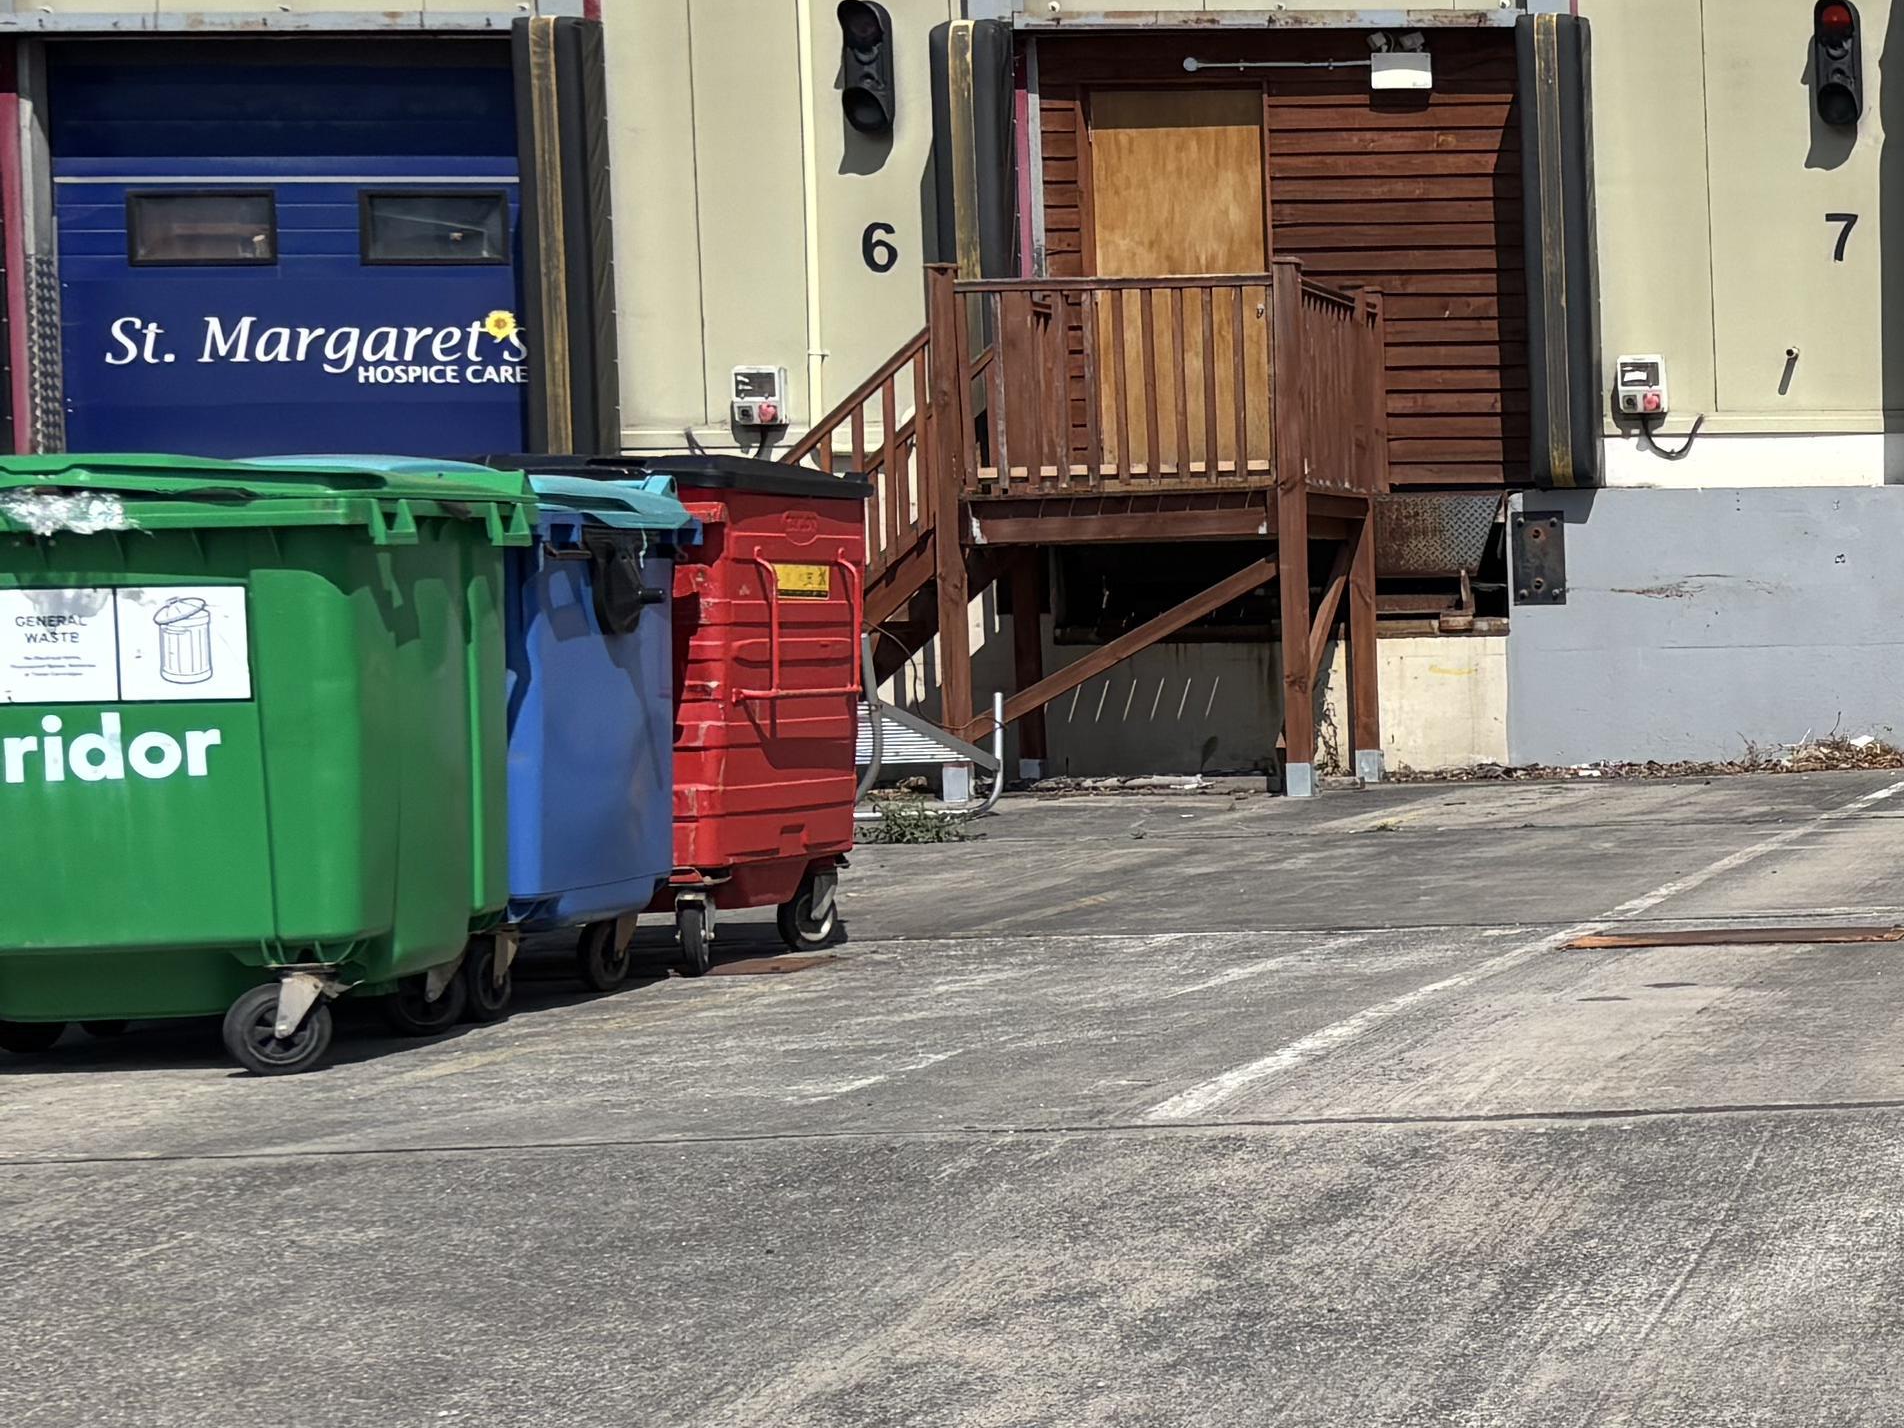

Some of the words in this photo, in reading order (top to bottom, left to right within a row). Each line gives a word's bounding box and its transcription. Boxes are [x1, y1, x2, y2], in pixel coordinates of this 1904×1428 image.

[861, 222, 898, 273] 6
[1825, 213, 1859, 262] 7
[105, 316, 176, 365] St.
[357, 364, 460, 384] HOSPICE
[466, 364, 529, 384] CARE
[15, 615, 88, 627] GENERAL
[24, 632, 80, 644] WASTE
